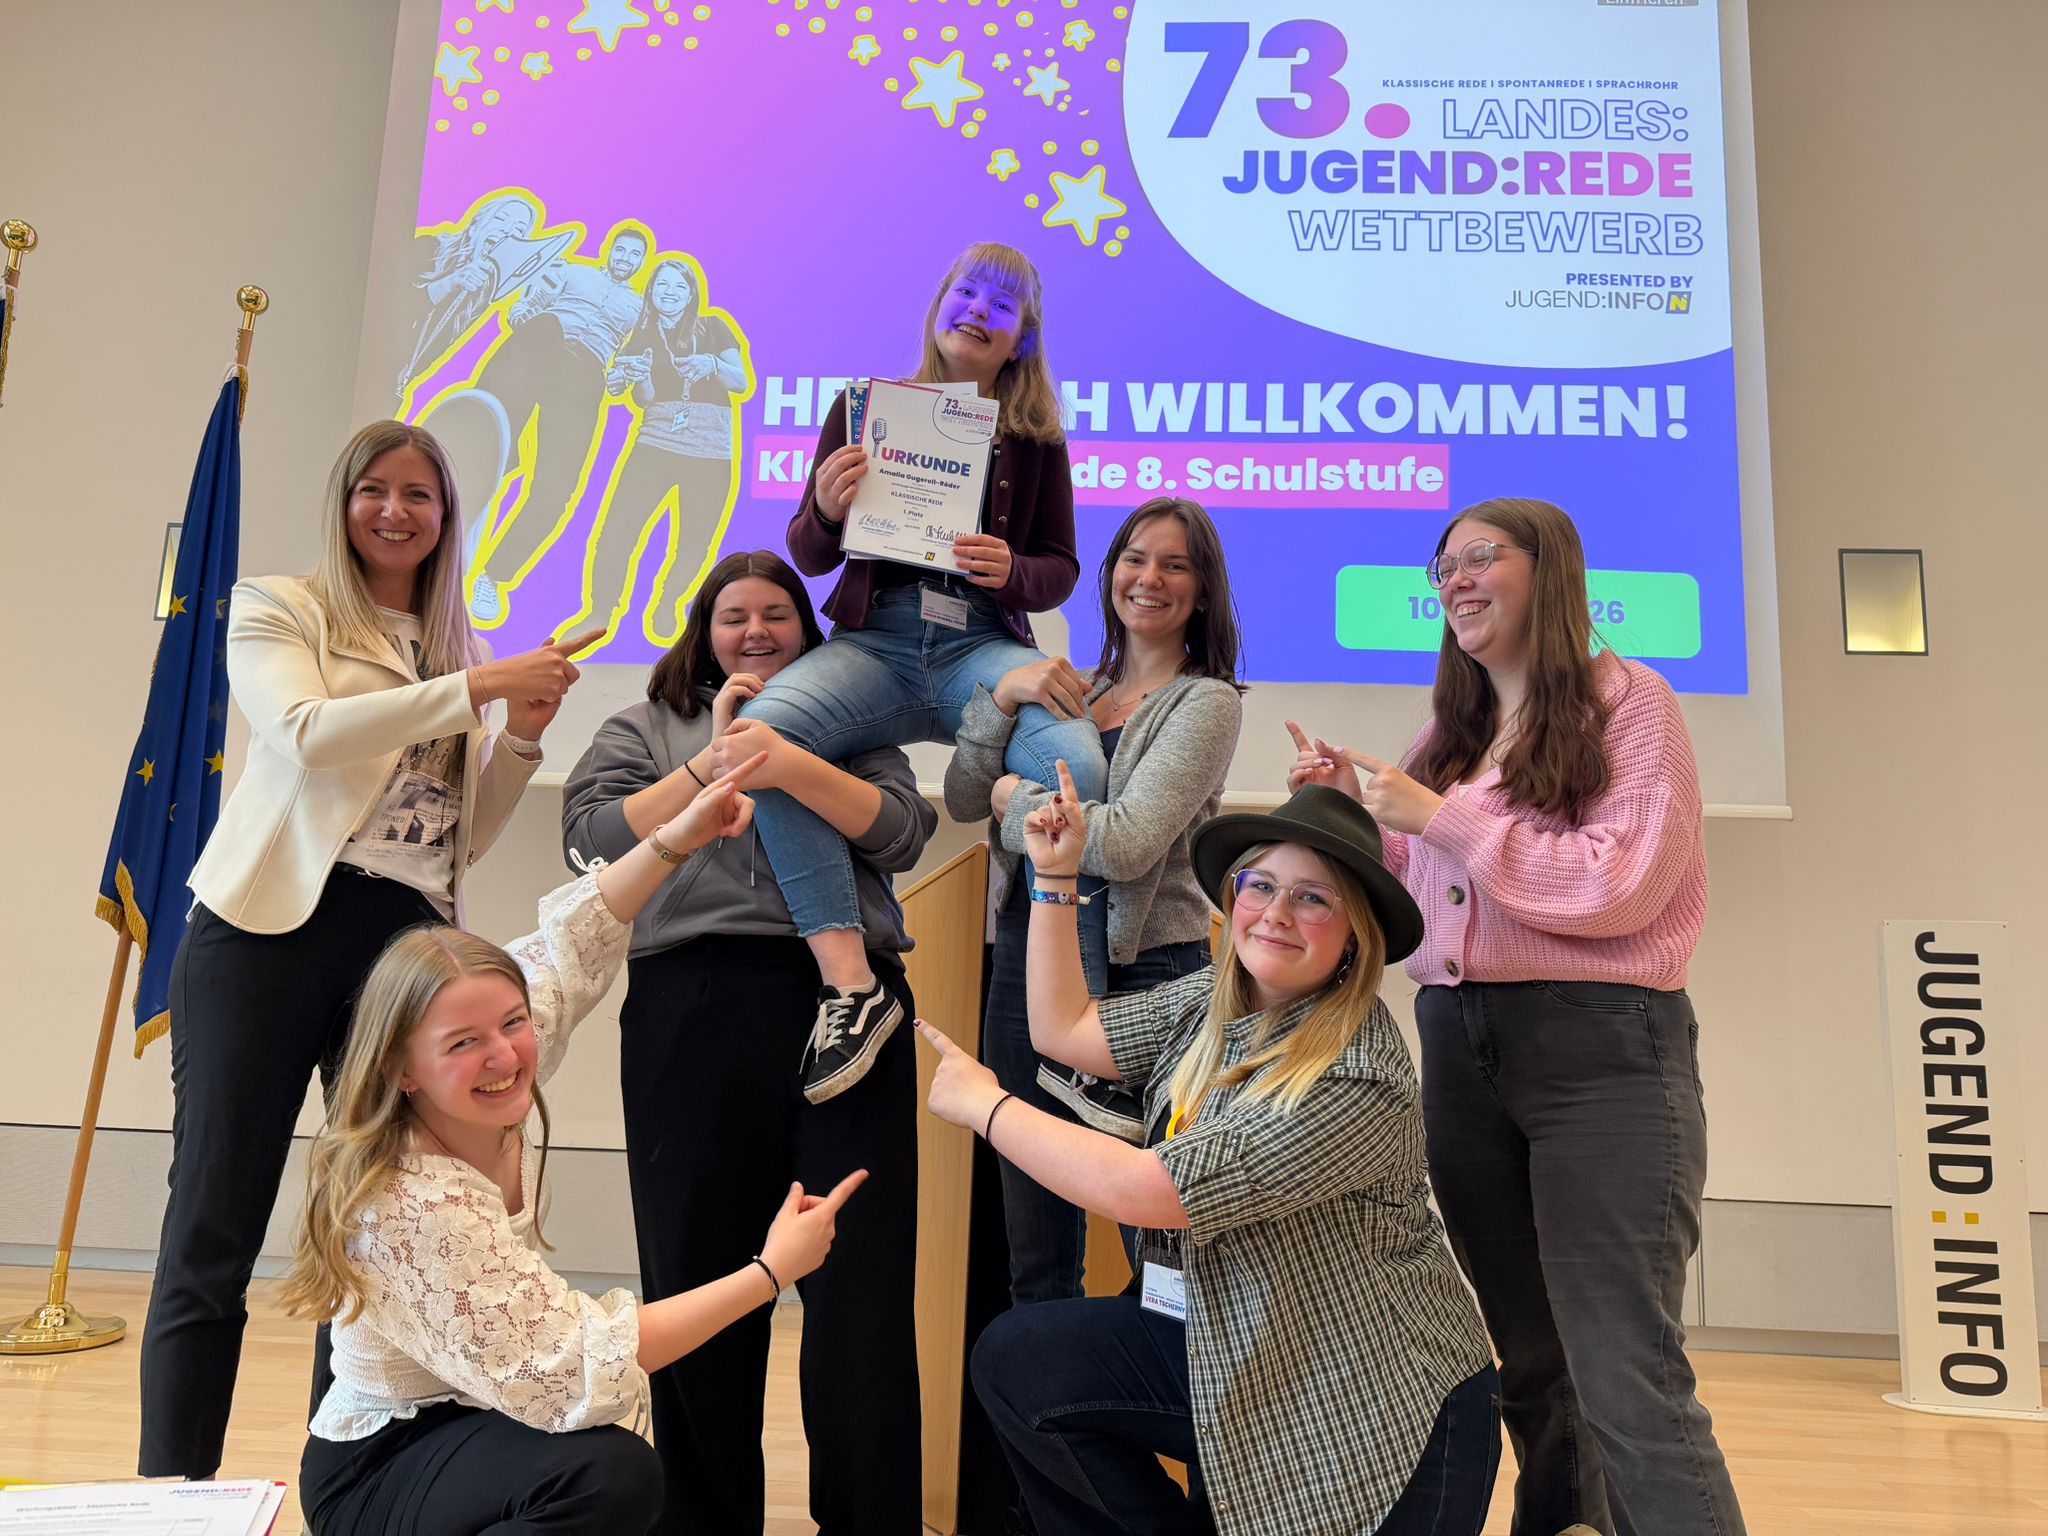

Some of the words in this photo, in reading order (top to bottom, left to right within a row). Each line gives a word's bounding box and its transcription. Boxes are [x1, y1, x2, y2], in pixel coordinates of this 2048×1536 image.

[1164, 19, 1411, 139] 73.
[1382, 79, 1454, 88] KLASSISCHE
[1458, 79, 1488, 88] REDE
[1497, 79, 1585, 88] SPONTANREDE
[1595, 79, 1679, 90] SPRACHROHR
[1442, 98, 1689, 142] LANDES:
[1222, 150, 1694, 198] JUGEND:REDE
[1288, 209, 1704, 256] WETTBEWERB
[1565, 273, 1666, 288] PRESENTED
[1669, 276, 1694, 288] BY
[1505, 290, 1664, 311] JUGEND:INFO
[941, 408, 995, 423] JUGEND:REDE
[945, 397, 962, 410] 73.
[1125, 382, 1688, 440] WILLKOMMEN!
[881, 447, 971, 477] URKUNDE
[1136, 456, 1177, 490] 8.
[1186, 456, 1444, 492] Schulstufe
[890, 491, 927, 503] KLASSISCHE
